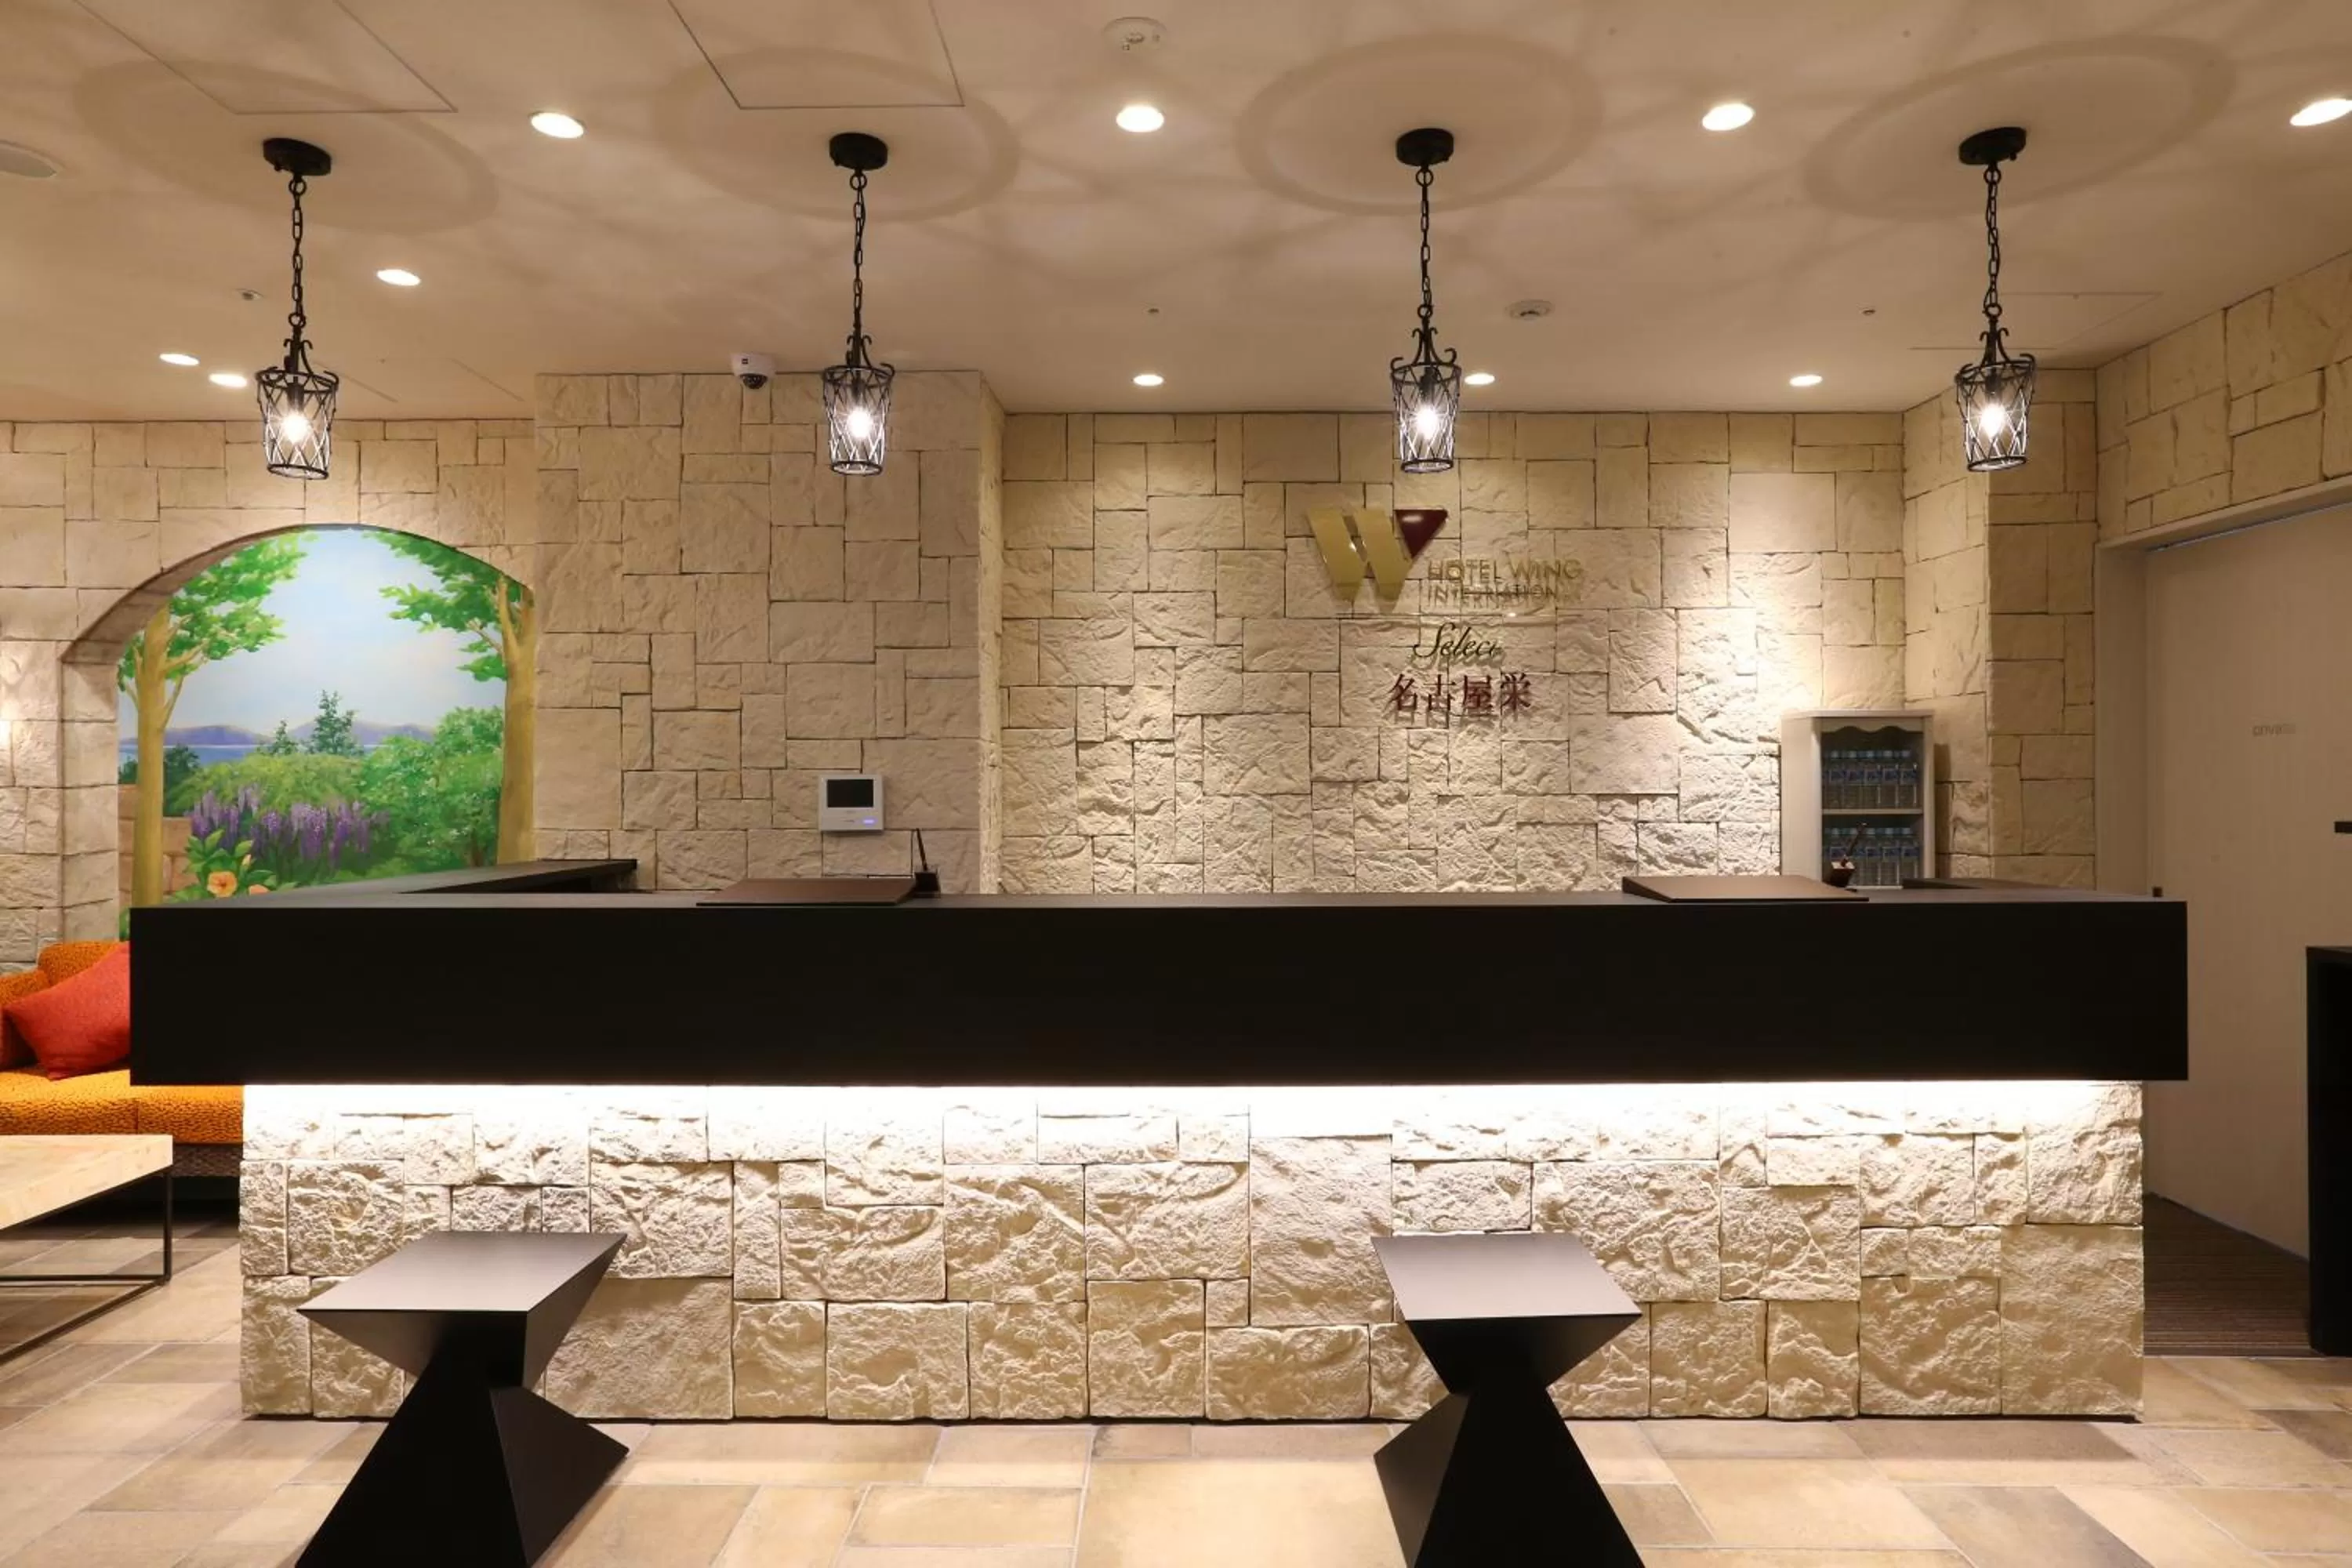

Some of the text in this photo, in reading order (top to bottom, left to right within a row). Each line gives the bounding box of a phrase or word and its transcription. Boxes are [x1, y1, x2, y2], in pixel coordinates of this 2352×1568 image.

[1427, 558, 1583, 580] HOTEL WING
[1413, 622, 1502, 658] Select
[1388, 673, 1531, 713] 名古屋栄
